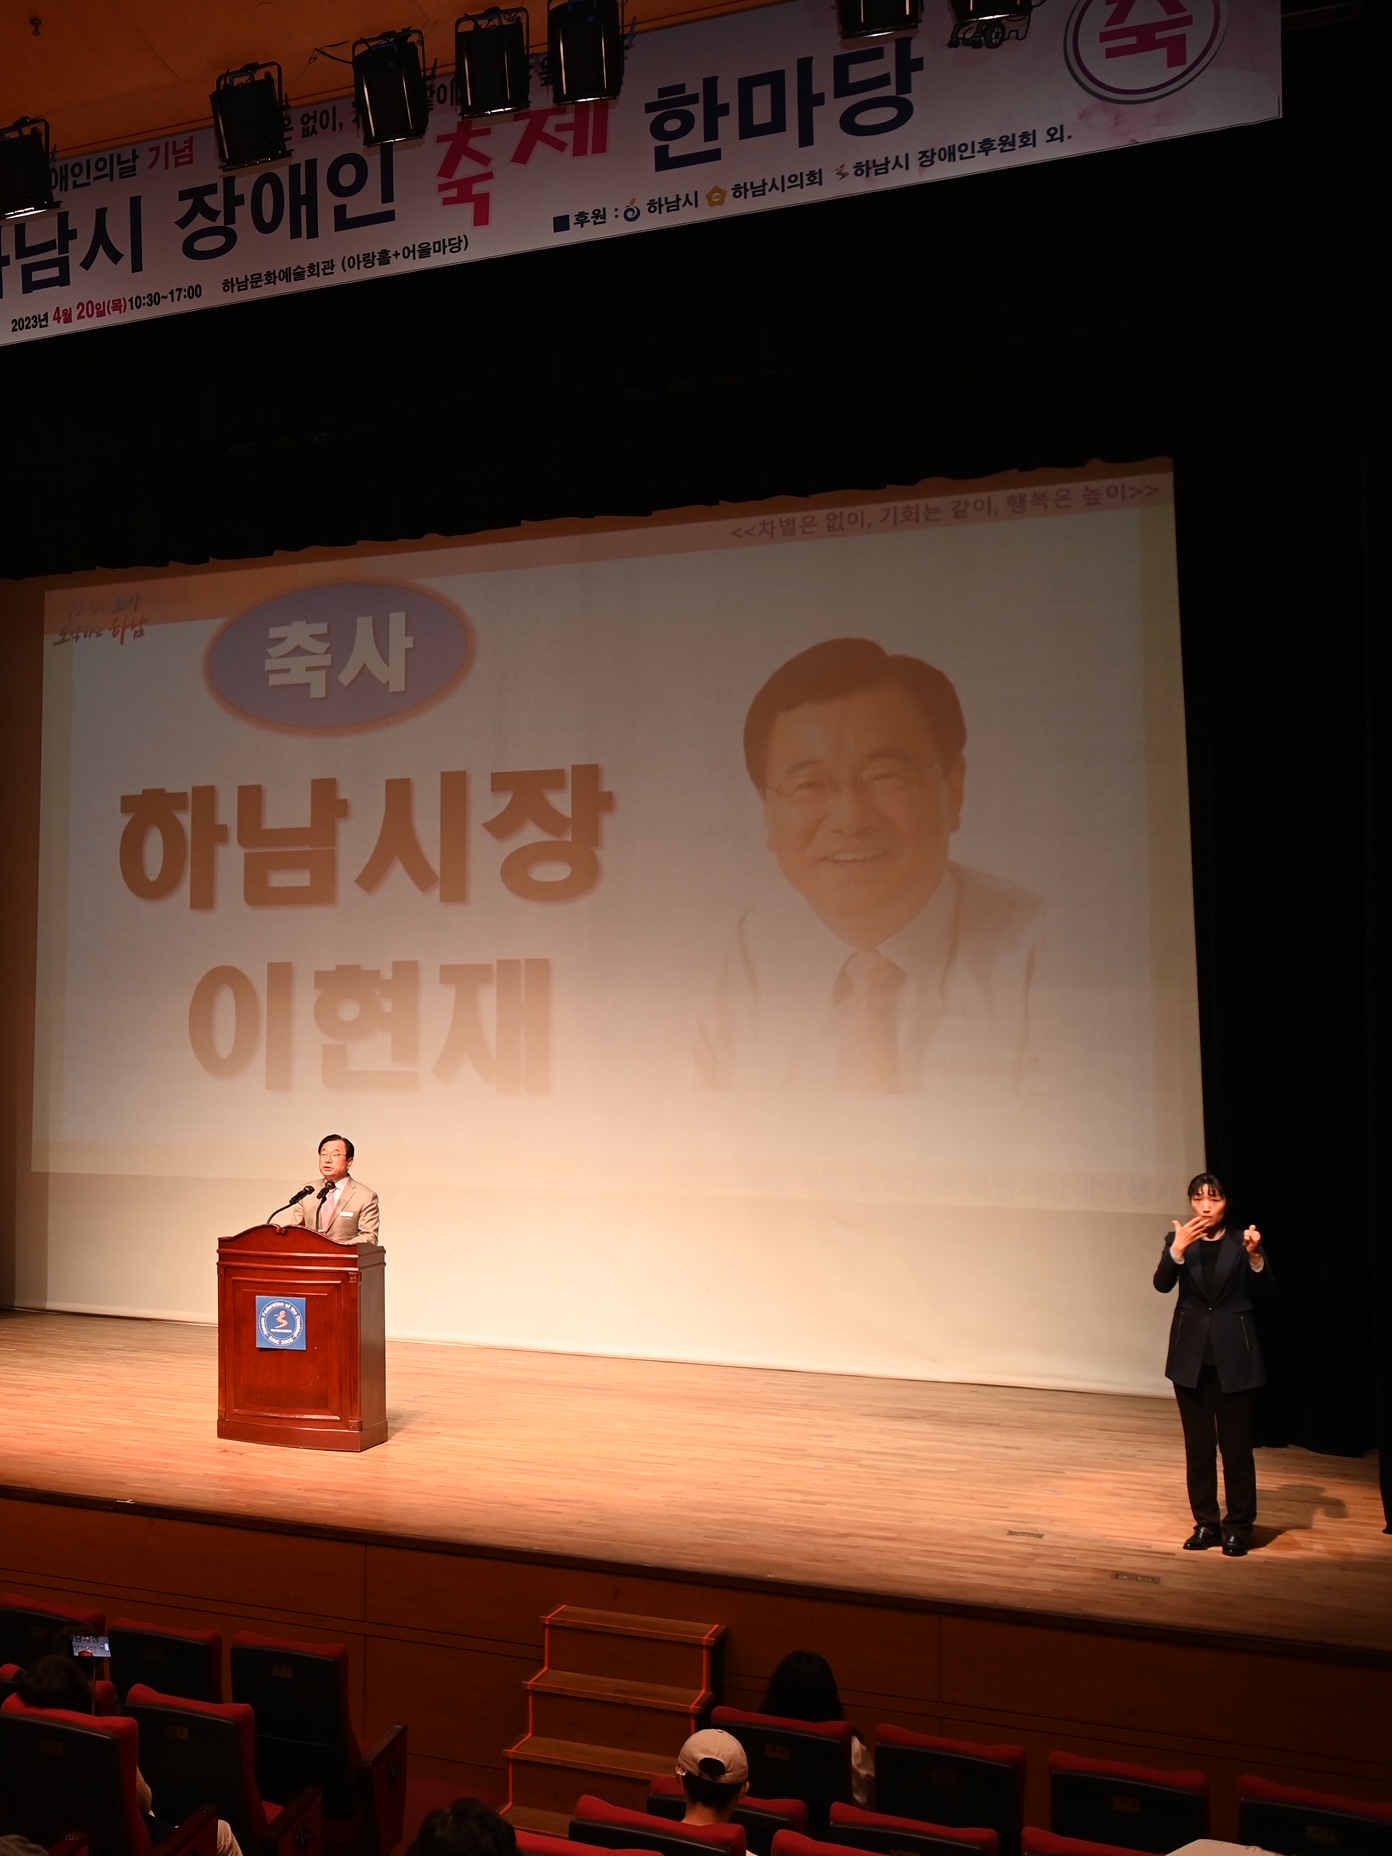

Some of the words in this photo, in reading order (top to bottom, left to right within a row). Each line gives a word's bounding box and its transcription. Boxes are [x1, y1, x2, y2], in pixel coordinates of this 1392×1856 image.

[148, 136, 193, 170] 기념
[175, 143, 395, 261] 장애인
[437, 102, 607, 227] 축제
[644, 37, 924, 172] 한마당
[300, 106, 343, 138] 없이,
[573, 207, 607, 228] 후원
[646, 190, 699, 215] 하남시
[731, 168, 824, 200] 하남시의회
[853, 152, 910, 179] 하남시
[917, 129, 1037, 168] 장애인후원회
[1045, 123, 1073, 144] 외.
[11, 310, 50, 333] 2023년
[52, 305, 74, 324] 4월
[221, 259, 336, 294] 하남문화예술회관
[340, 233, 470, 273] (아랑홀+어울마당)
[730, 511, 818, 540] <<차별은
[826, 508, 873, 532] 없이,
[880, 502, 941, 527] 기회는
[950, 496, 999, 519] 같이,
[1006, 487, 1073, 513] 행복은
[1083, 482, 1160, 507] 높이>>
[265, 610, 414, 699] 축사
[118, 763, 616, 912] 하남시장
[188, 958, 551, 1094] 이현재
